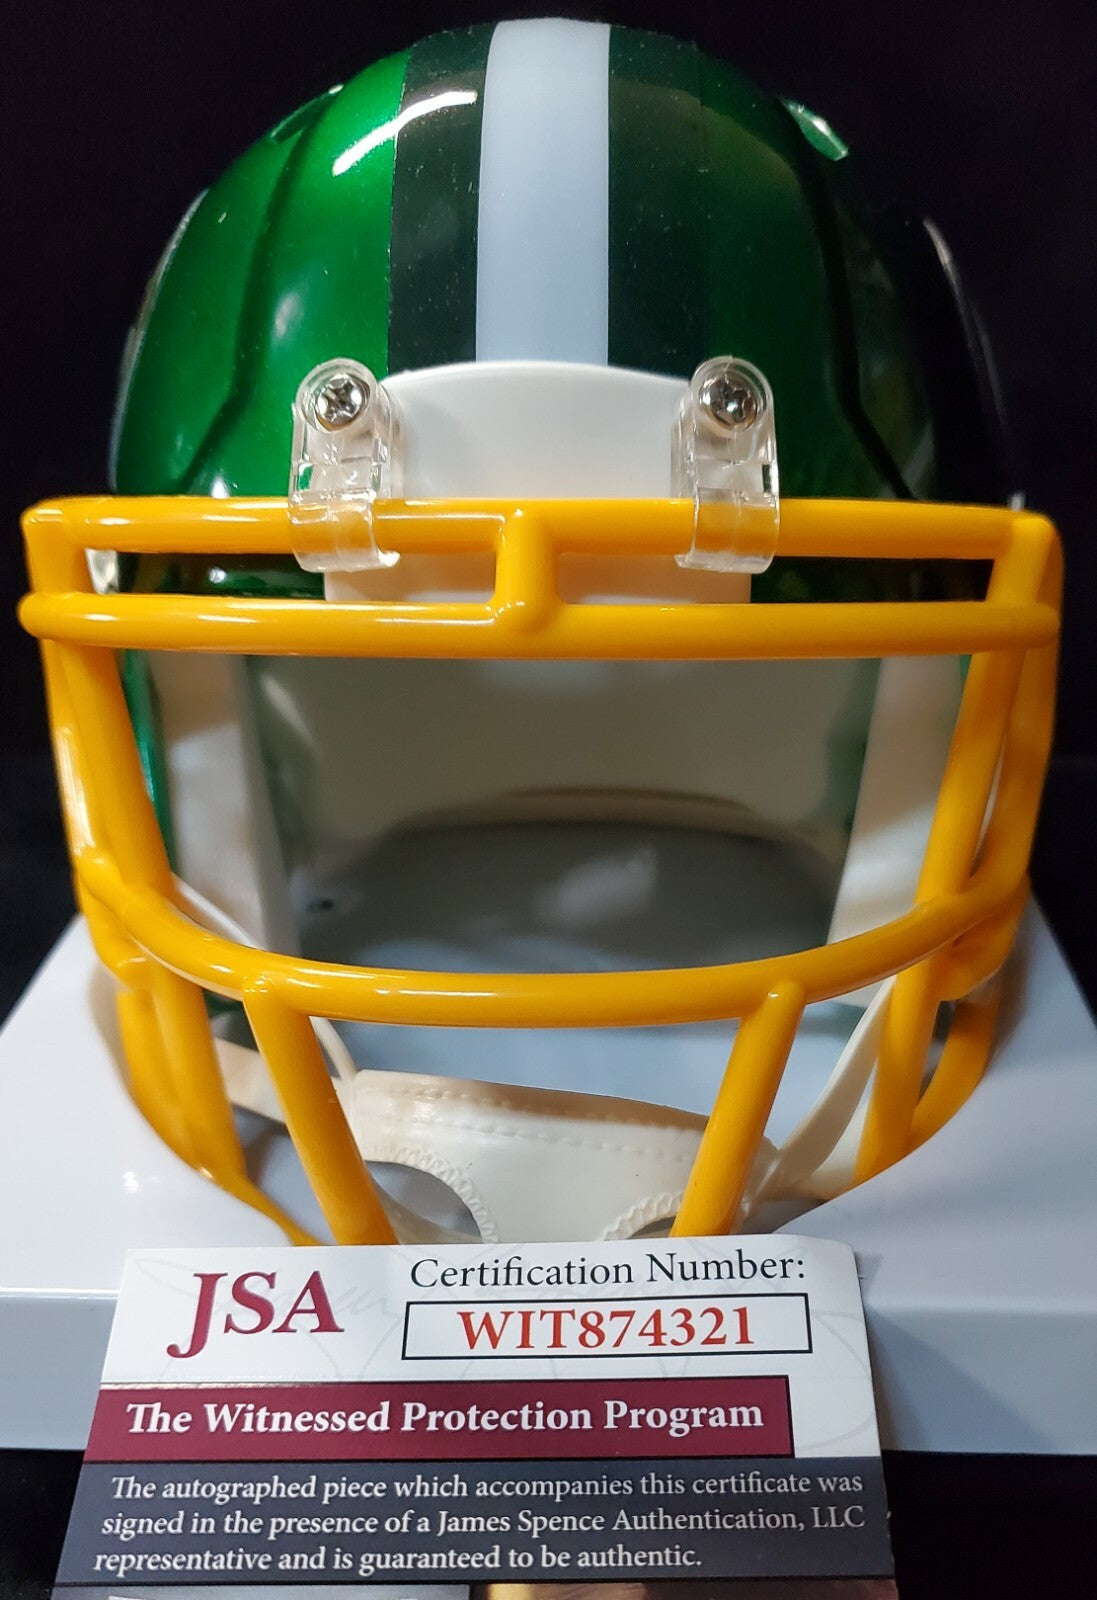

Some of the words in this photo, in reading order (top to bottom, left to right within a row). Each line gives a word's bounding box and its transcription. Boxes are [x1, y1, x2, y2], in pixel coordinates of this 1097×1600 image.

[410, 1256, 634, 1288] Certification
[646, 1249, 805, 1283] Number:
[166, 1271, 344, 1359] JSA
[456, 1307, 754, 1350] WIT874321
[126, 1401, 193, 1433] The
[203, 1400, 391, 1433] Witnessed
[400, 1401, 593, 1431] Protection
[603, 1400, 765, 1438] Program
[111, 1475, 157, 1499] The
[161, 1474, 317, 1506] autographed
[322, 1476, 387, 1503] piece
[393, 1474, 468, 1497] which
[475, 1475, 633, 1503] accompanies
[639, 1472, 685, 1495] this
[692, 1470, 811, 1494] certificate
[817, 1475, 863, 1492] was
[101, 1510, 185, 1541] signed
[190, 1512, 216, 1534] in
[223, 1509, 264, 1534] the
[267, 1517, 379, 1540] presence
[384, 1509, 415, 1533] of
[416, 1516, 431, 1533] a
[436, 1510, 511, 1537] James
[517, 1509, 605, 1537] Spence
[611, 1507, 804, 1531] Authentication,
[811, 1505, 865, 1528] LLC
[93, 1547, 272, 1577] representative
[278, 1545, 326, 1570] and
[333, 1547, 353, 1569] is
[358, 1544, 501, 1576] guaranteed
[508, 1549, 534, 1568] to
[540, 1544, 571, 1568] be
[577, 1543, 702, 1568] authentic.
